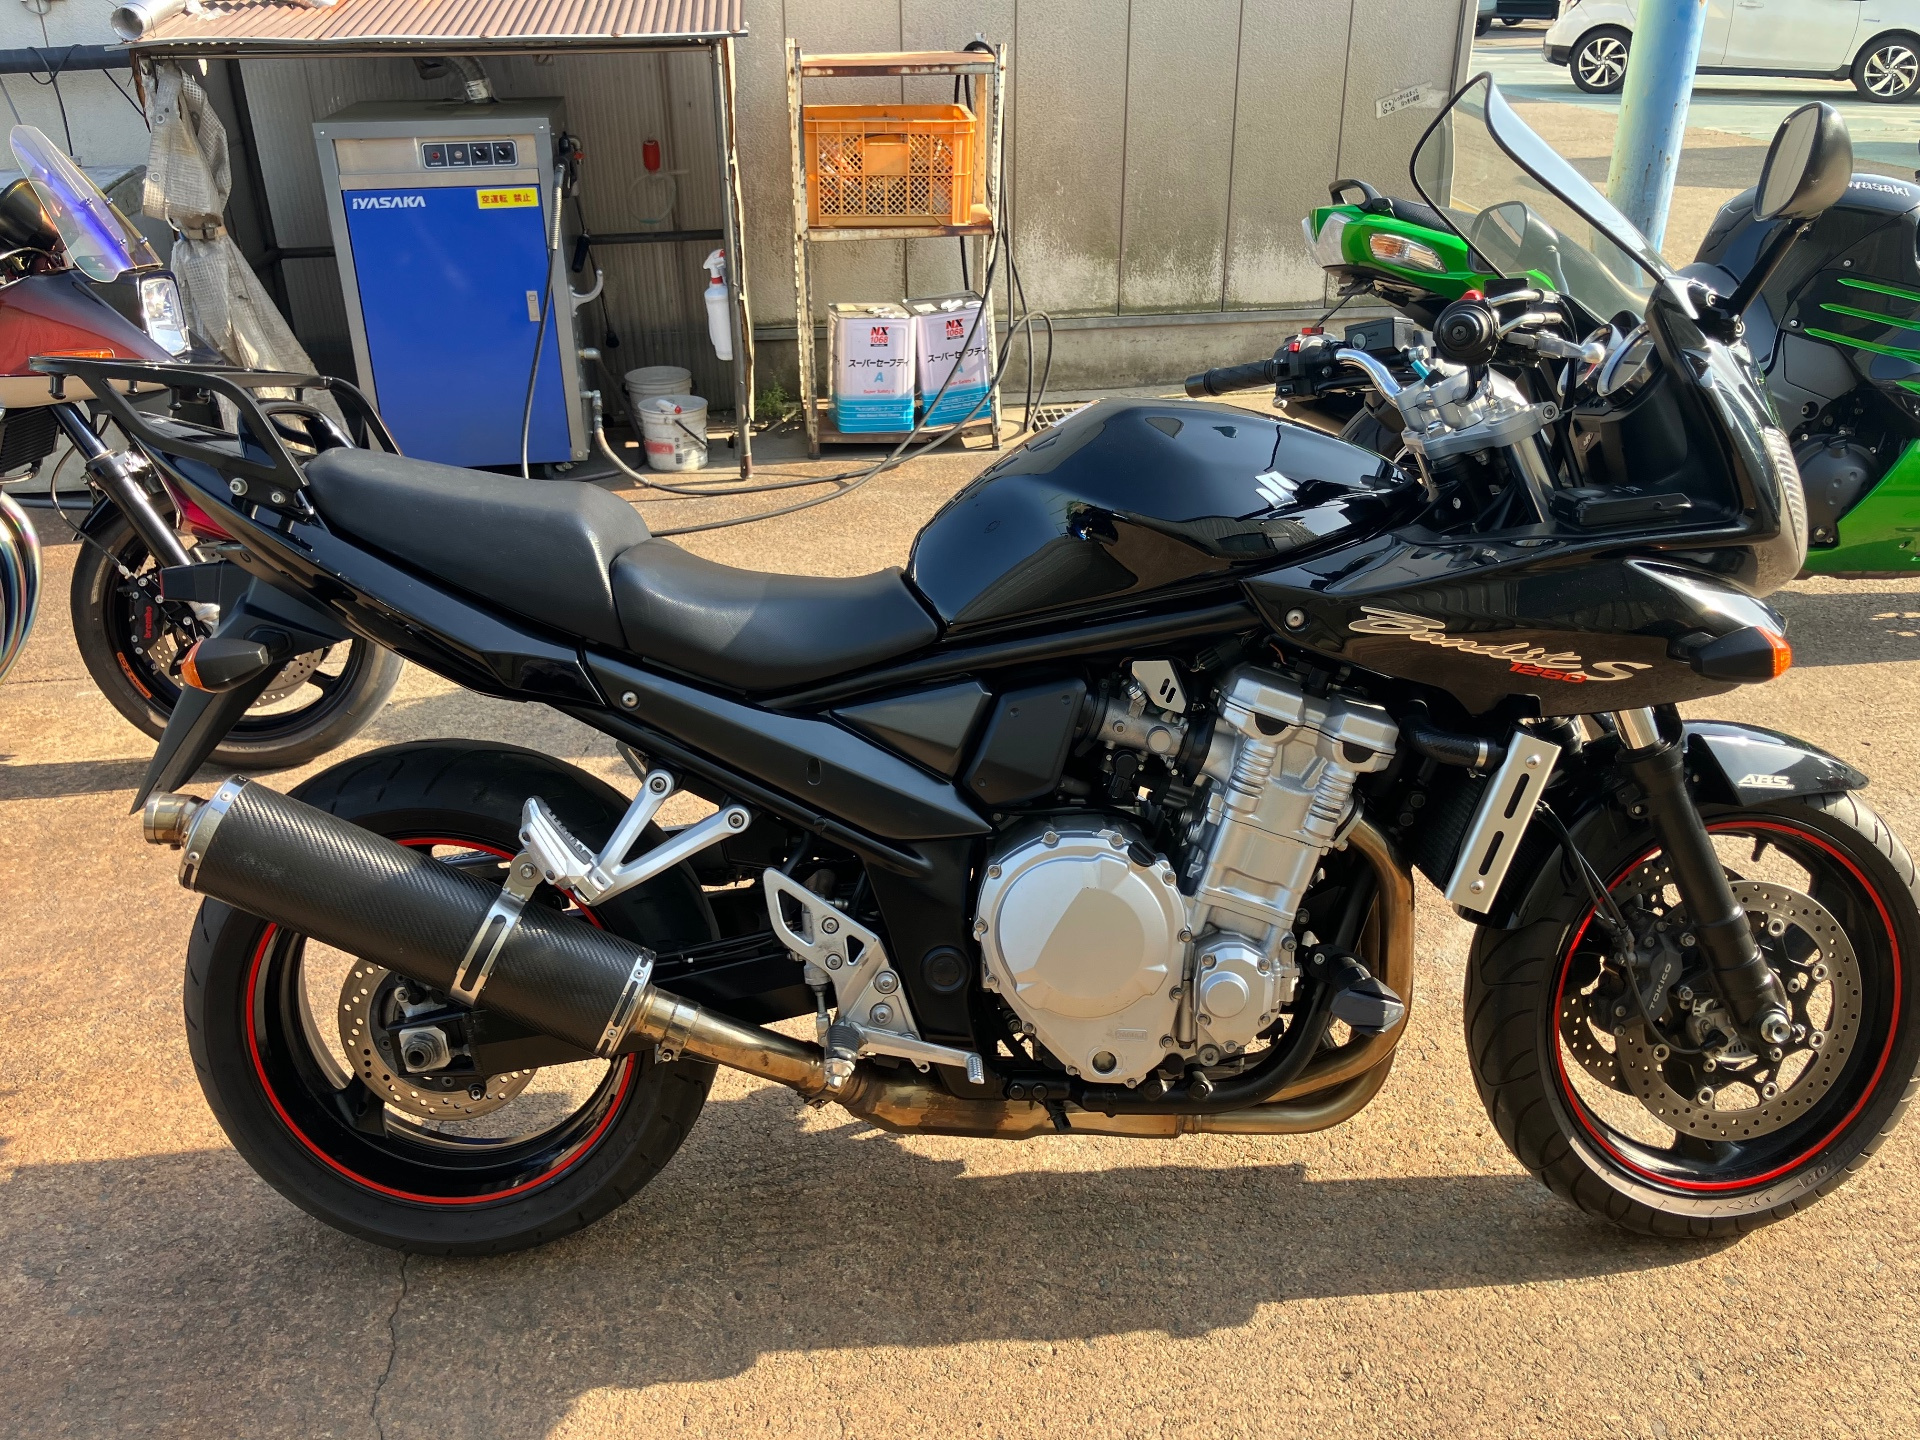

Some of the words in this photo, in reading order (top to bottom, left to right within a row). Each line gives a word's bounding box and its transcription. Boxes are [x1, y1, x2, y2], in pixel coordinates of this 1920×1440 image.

[1847, 181, 1910, 197] wasaki
[481, 194, 508, 204] 空運転
[513, 193, 532, 203] 禁止
[945, 318, 964, 329] NX
[870, 326, 890, 336] NX
[946, 327, 964, 337] 1068
[870, 336, 888, 344] 1068
[927, 347, 988, 363] スーパーセフティ
[848, 358, 909, 368] スーパーセーフティ
[874, 372, 884, 383] A
[1348, 605, 1582, 669] Bandit
[1566, 661, 1654, 682] S
[1509, 662, 1588, 684] 1250
[1738, 773, 1790, 787] ABS
[1648, 963, 1672, 1010] TOKICO
